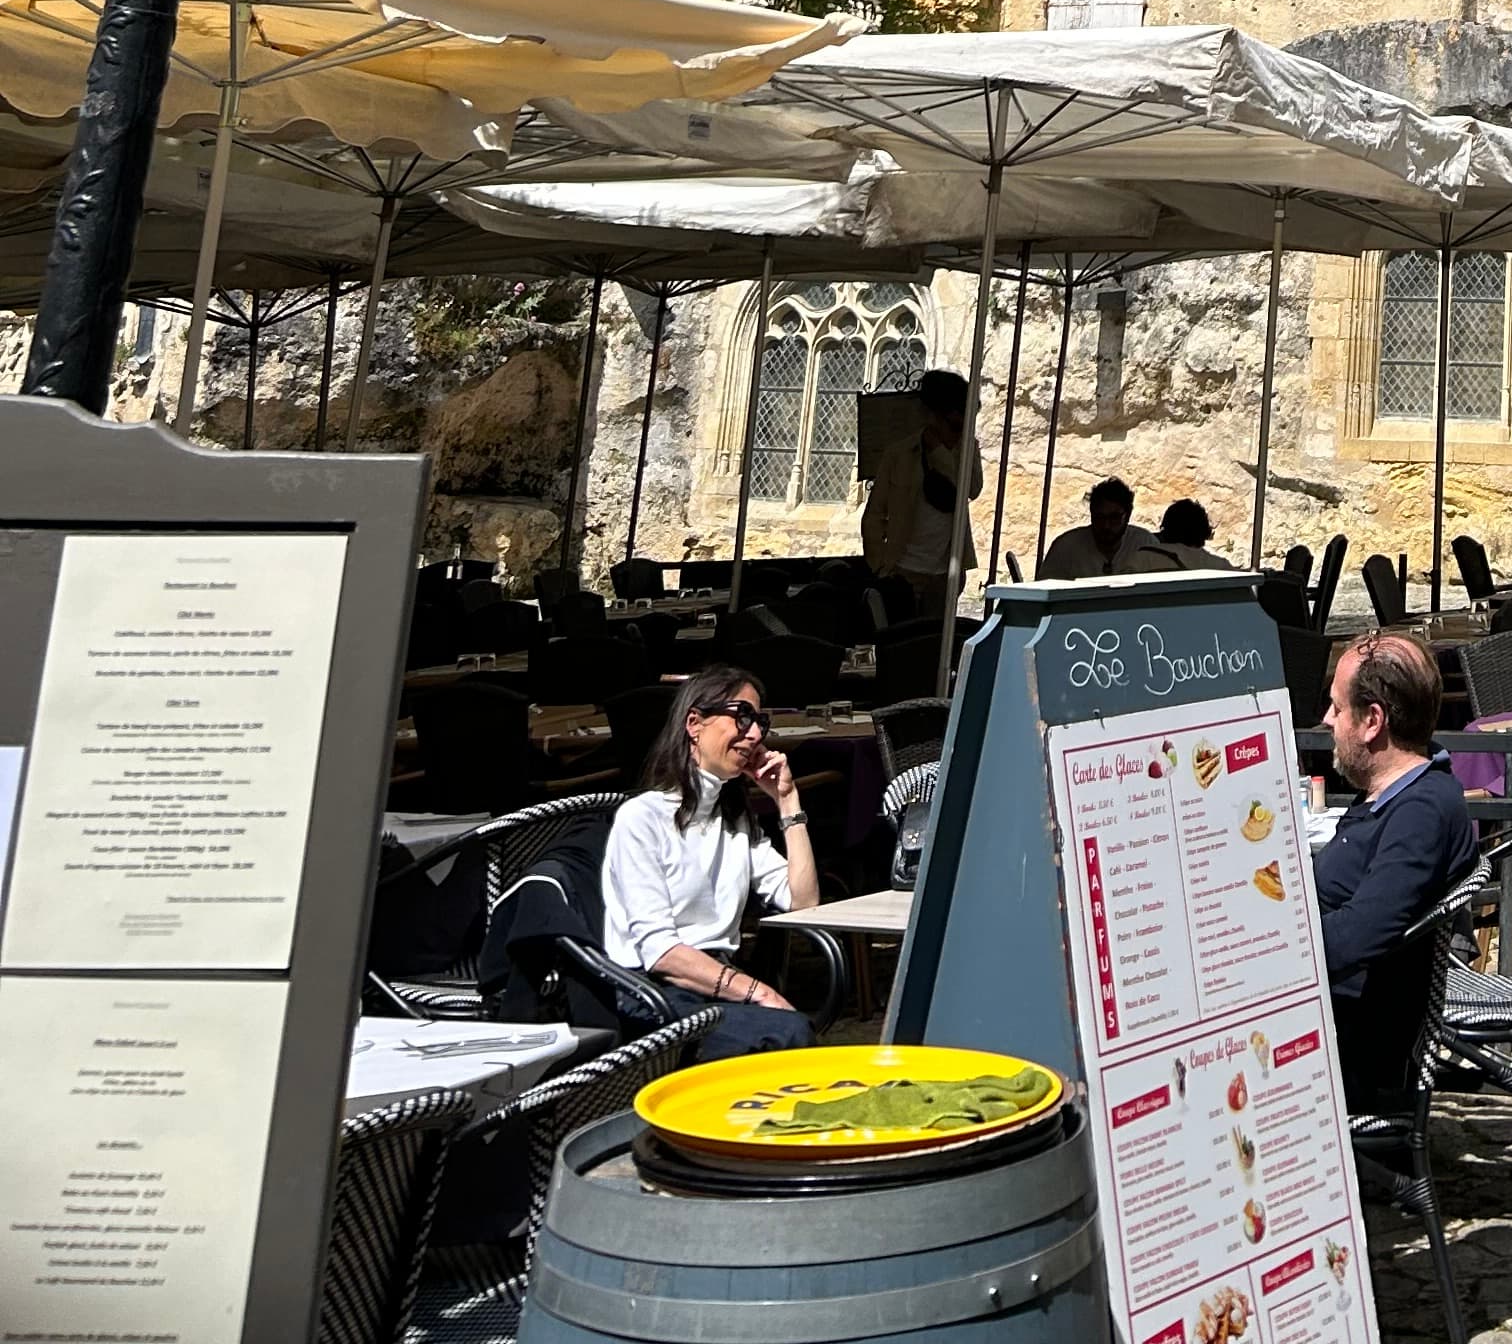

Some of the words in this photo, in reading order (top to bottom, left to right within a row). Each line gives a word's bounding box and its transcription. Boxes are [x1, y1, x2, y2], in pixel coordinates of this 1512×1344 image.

[1064, 628, 1130, 689] Le
[1137, 624, 1264, 696] Bouchon
[1072, 761, 1097, 785] Carte
[1099, 757, 1113, 781] des
[1115, 753, 1144, 784] Glaces
